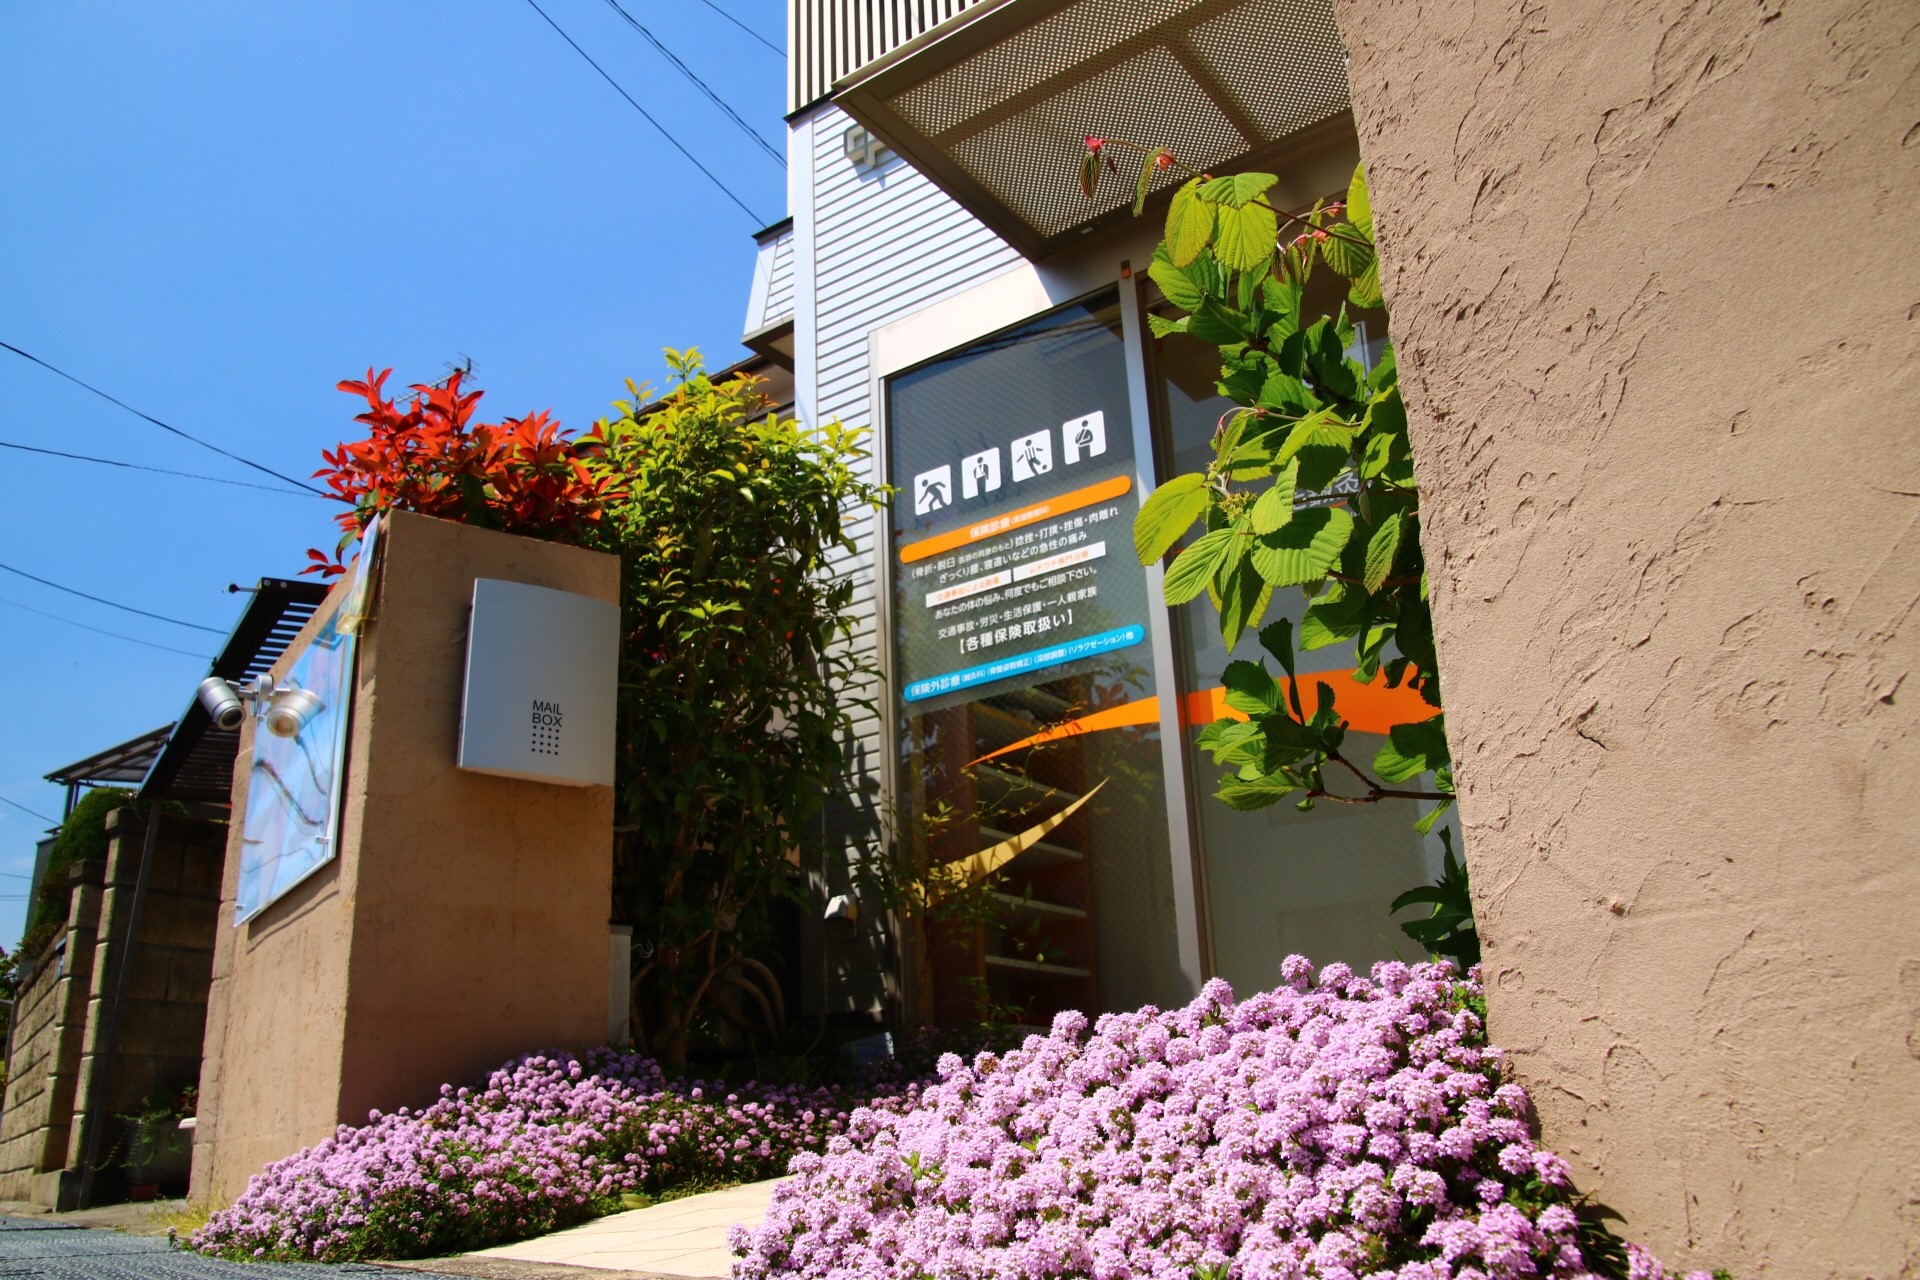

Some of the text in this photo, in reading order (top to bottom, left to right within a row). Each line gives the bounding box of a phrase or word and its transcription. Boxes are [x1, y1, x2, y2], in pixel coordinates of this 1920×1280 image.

[960, 608, 1073, 654] 【各種保険取扱い】
[532, 699, 563, 716] MAIL
[532, 712, 563, 728] BOX
